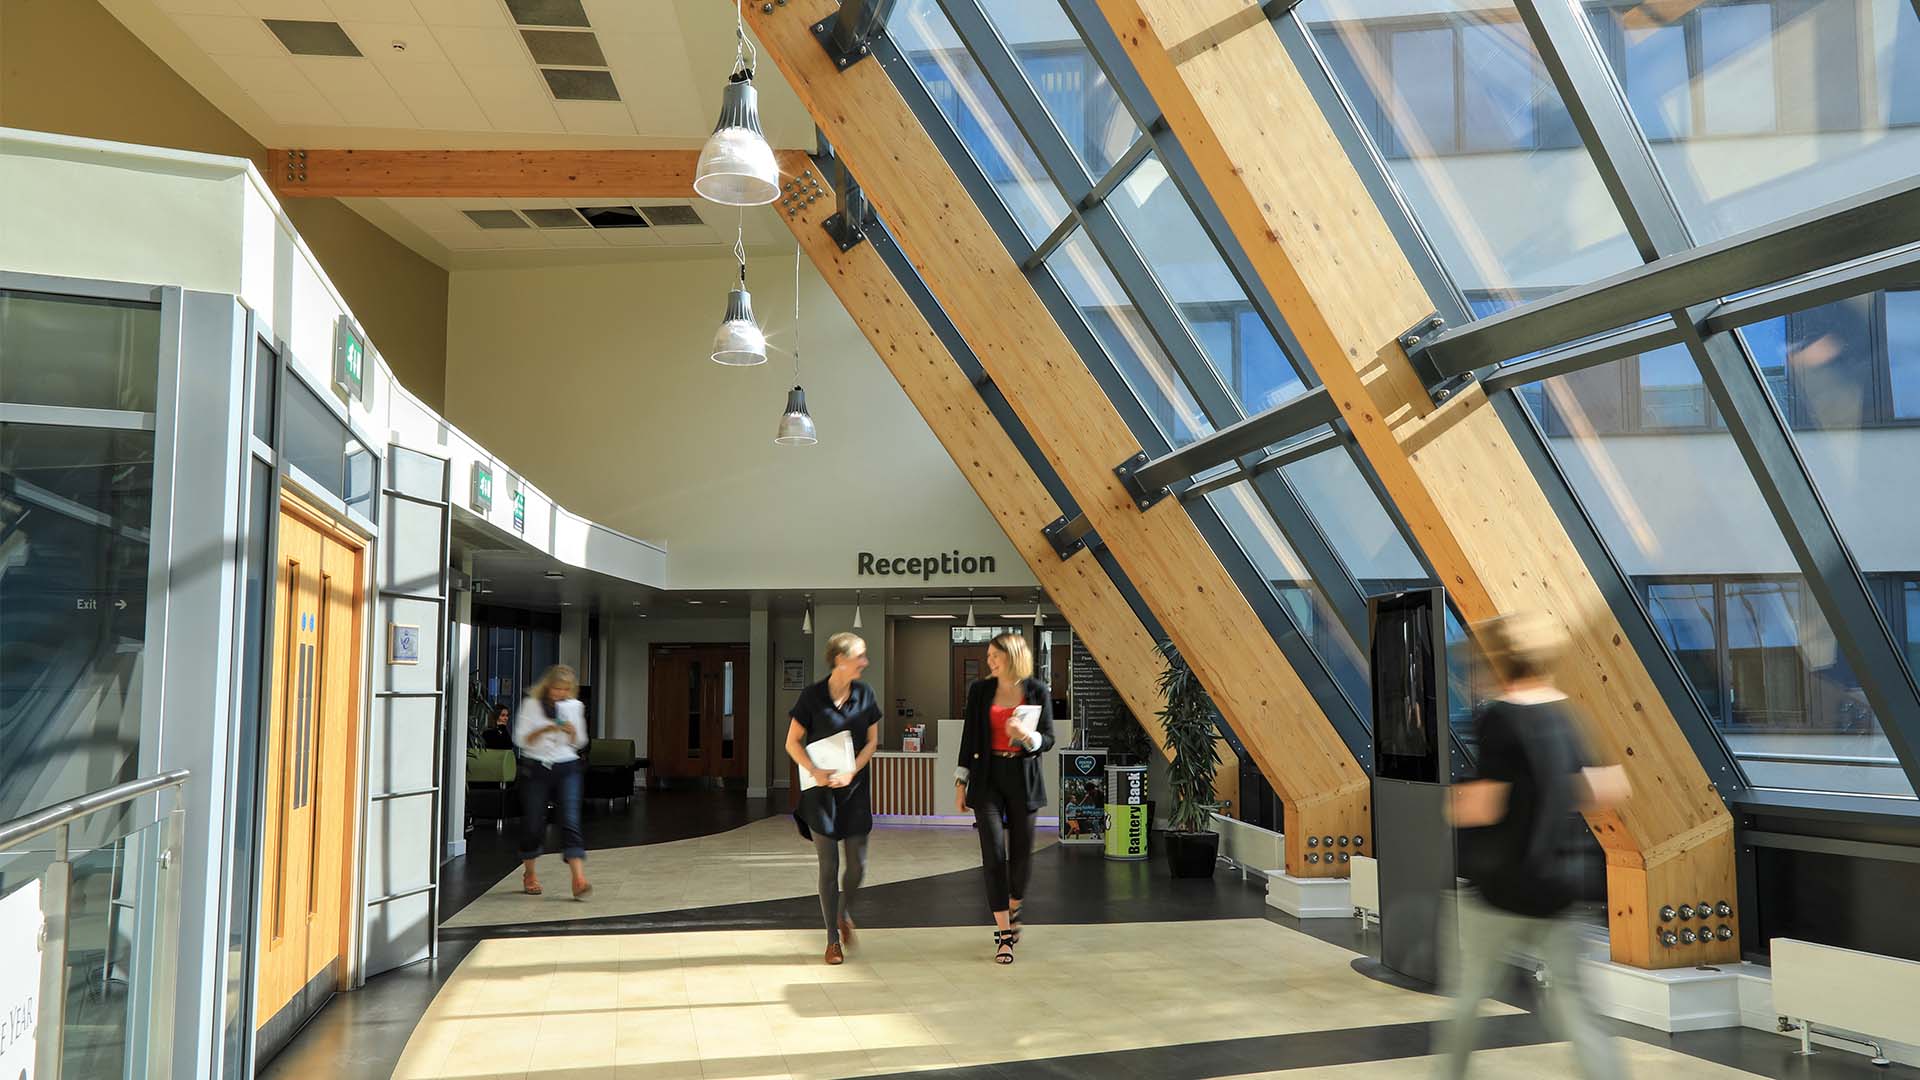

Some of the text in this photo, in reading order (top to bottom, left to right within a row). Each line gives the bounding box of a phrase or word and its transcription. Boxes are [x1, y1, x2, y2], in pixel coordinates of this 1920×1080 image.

[858, 550, 995, 581] Reception
[77, 599, 97, 610] Exit
[9, 996, 33, 1047] YEAR
